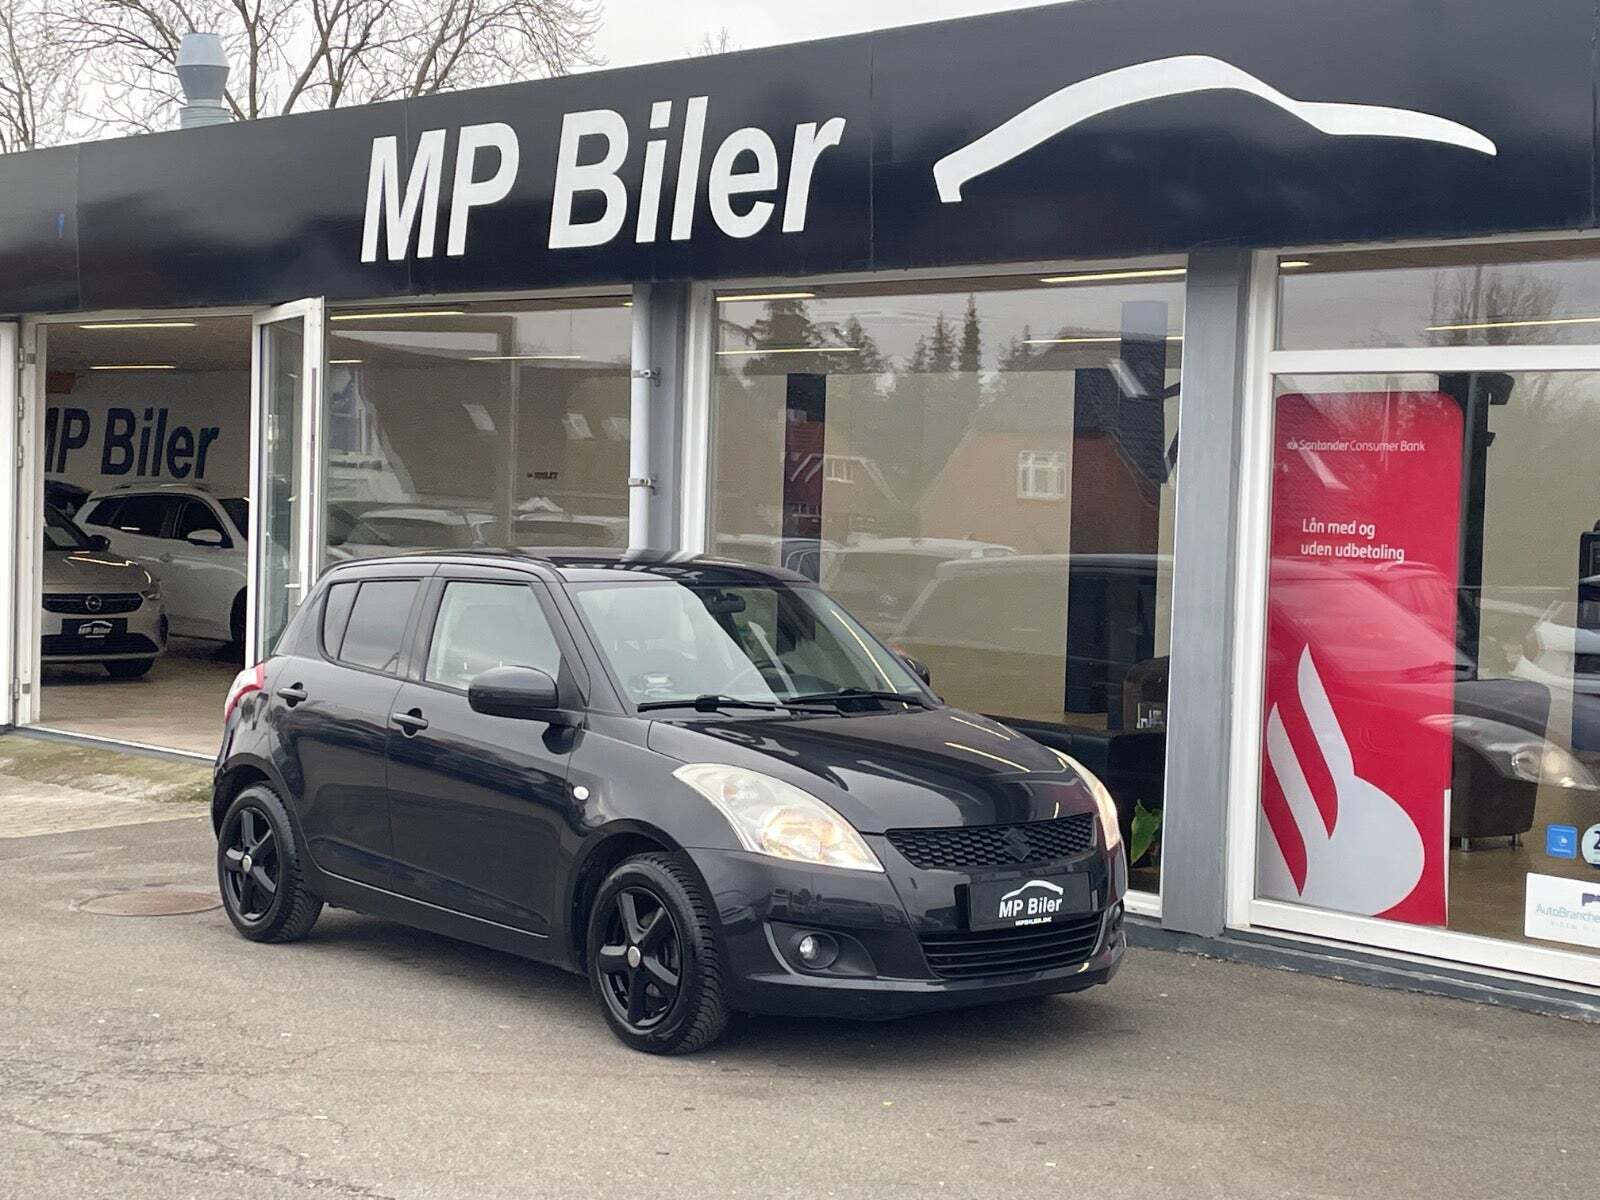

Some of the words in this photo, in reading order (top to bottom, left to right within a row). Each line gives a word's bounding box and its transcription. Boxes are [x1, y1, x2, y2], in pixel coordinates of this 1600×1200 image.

[361, 121, 520, 263] MP
[548, 96, 846, 250] Biler
[101, 407, 220, 479] Biler
[1299, 439, 1349, 451] Santander
[1350, 440, 1399, 452] Consumer
[1400, 440, 1425, 452] Bank
[1302, 517, 1325, 533] Lån
[1327, 520, 1356, 535] med
[1359, 524, 1375, 539] og
[1301, 541, 1332, 556] uden
[1335, 543, 1405, 564] udbetaling
[998, 899, 1024, 918] MP
[1027, 896, 1063, 915] Biler
